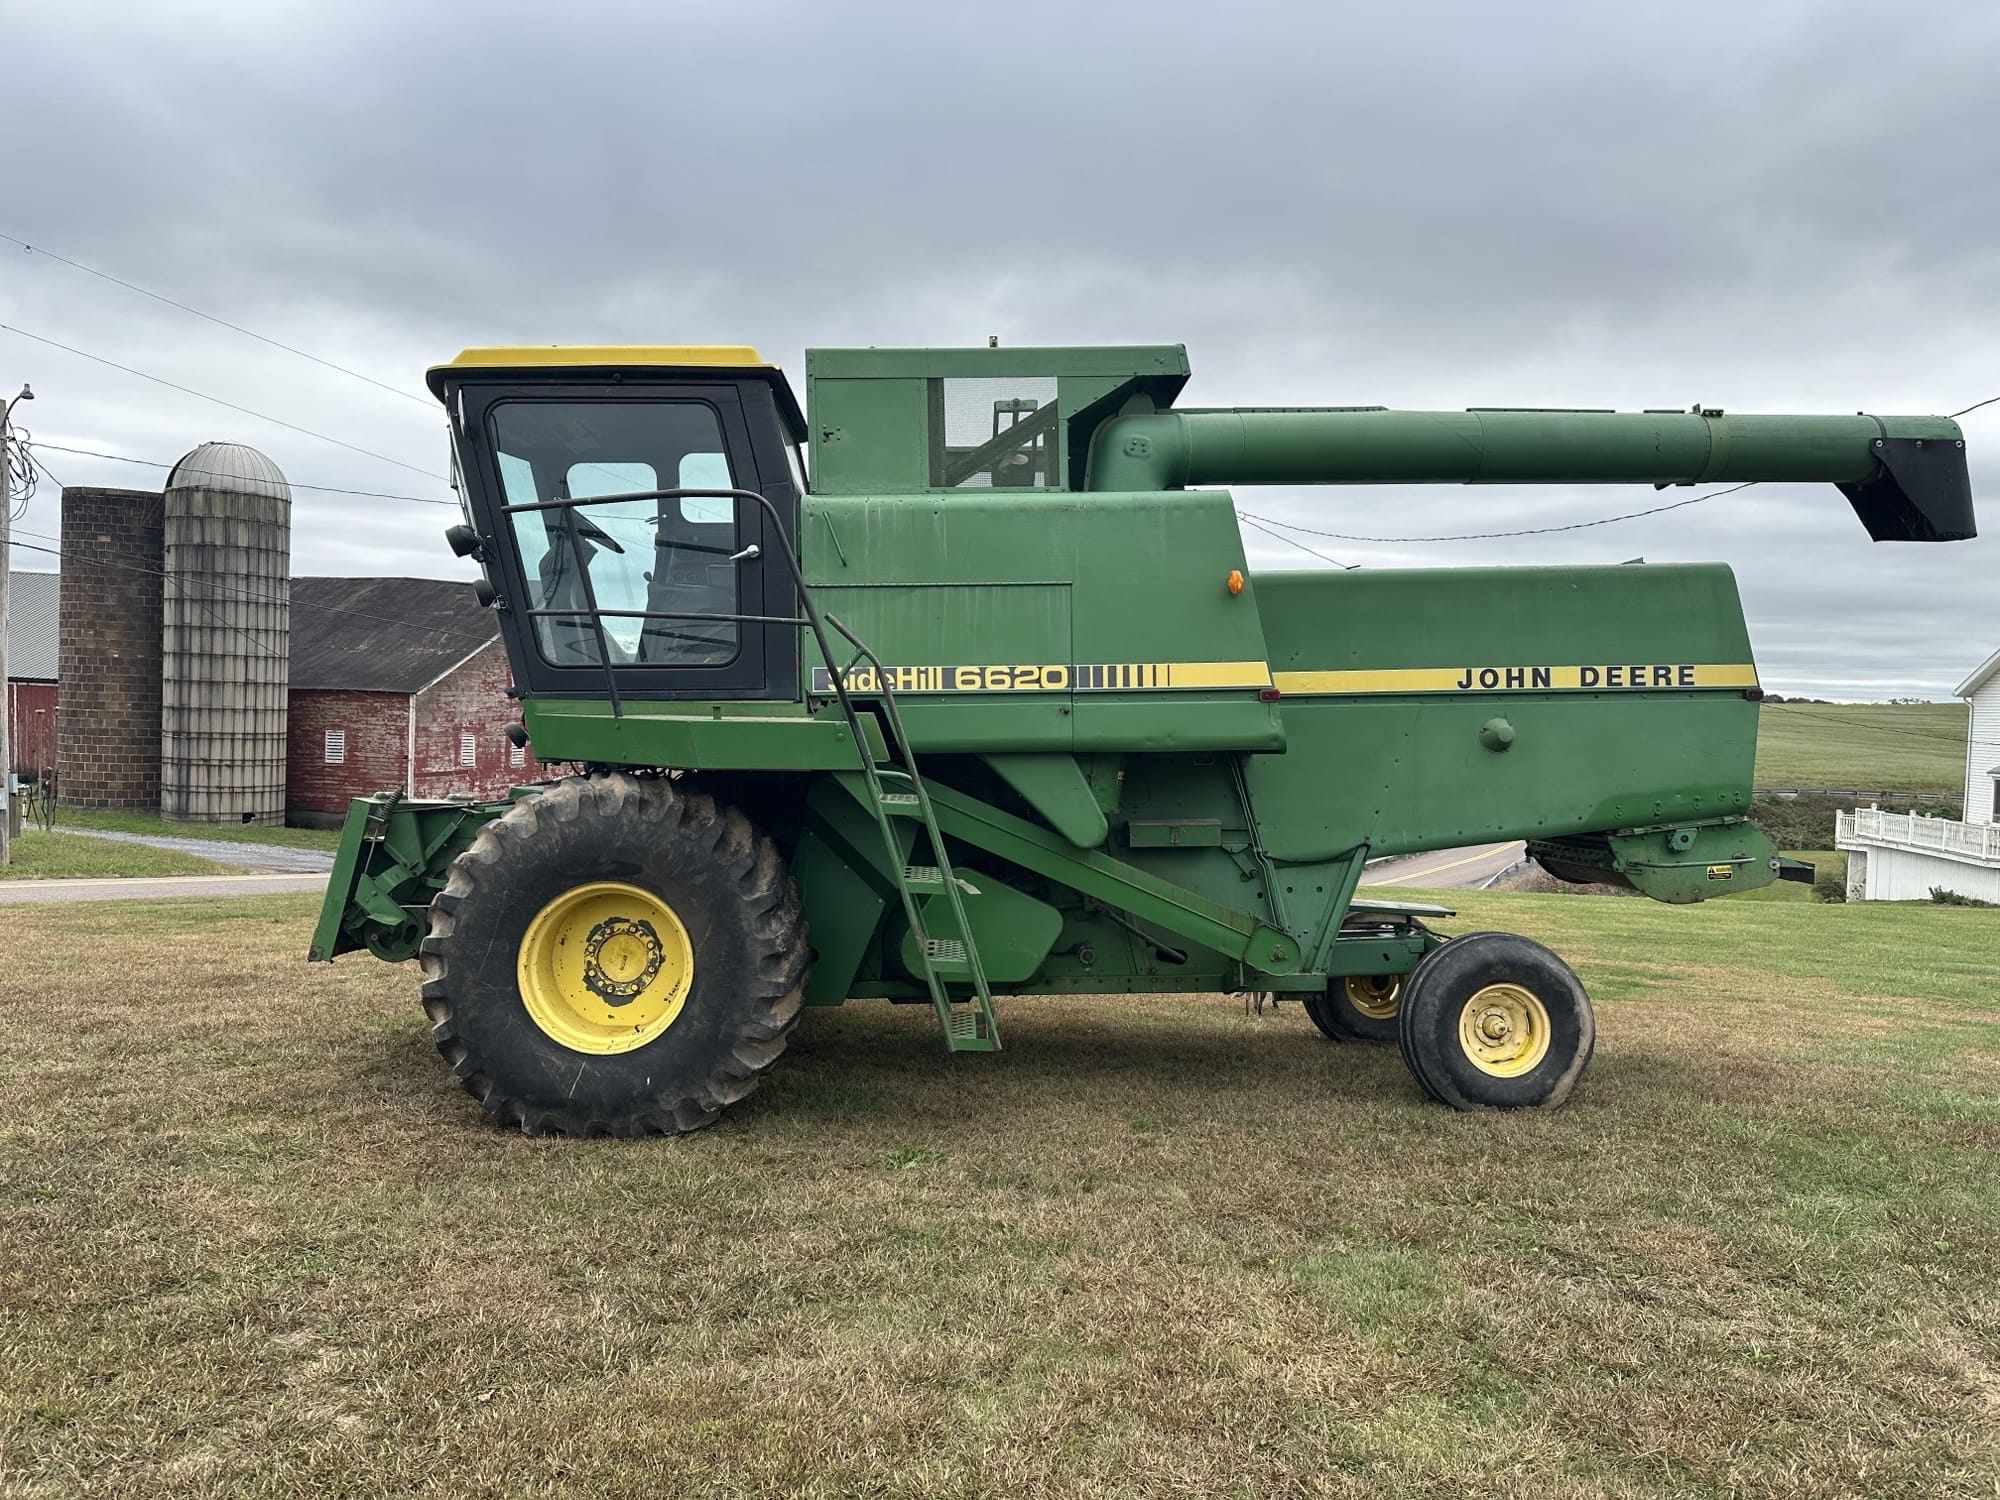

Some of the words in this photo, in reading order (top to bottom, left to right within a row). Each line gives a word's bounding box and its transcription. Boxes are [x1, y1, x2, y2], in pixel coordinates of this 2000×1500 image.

[954, 665, 1069, 690] 6620
[1457, 667, 1551, 689] JOHN
[1580, 665, 1695, 687] DEERE
